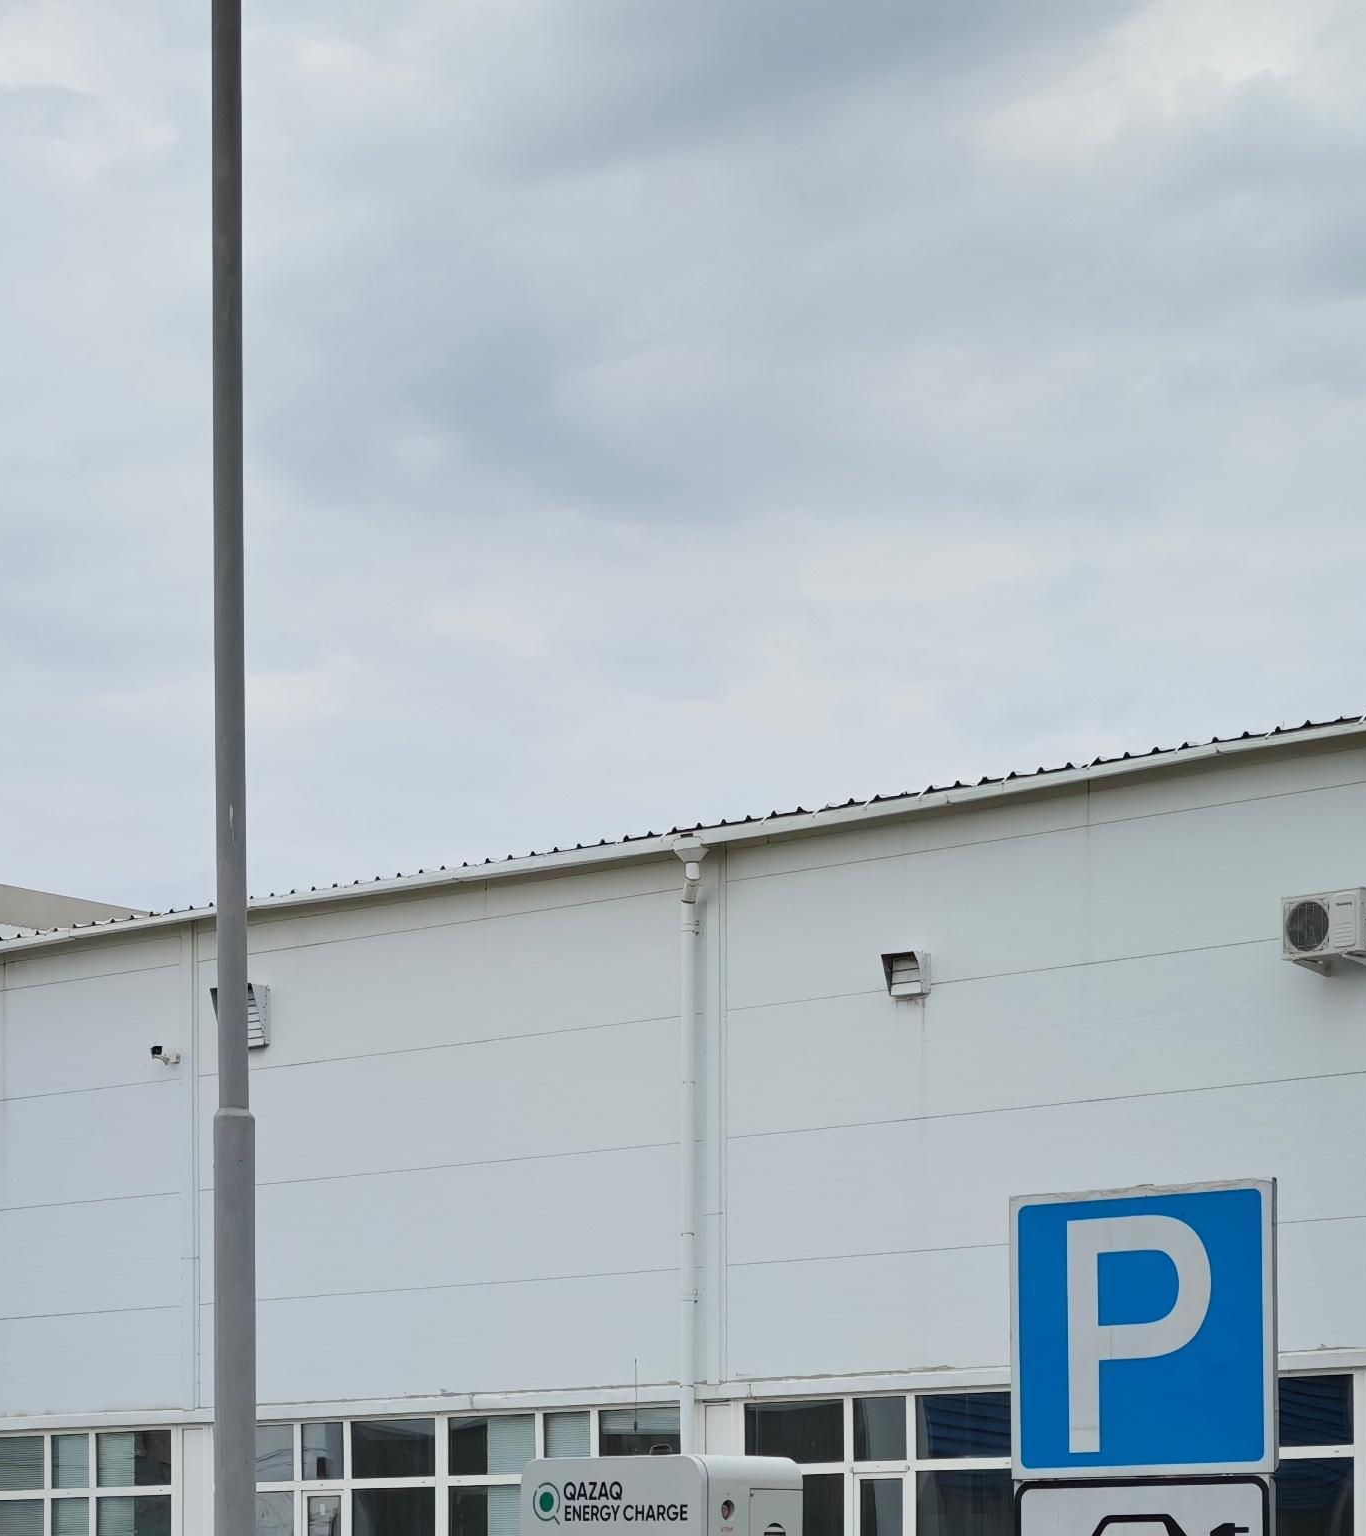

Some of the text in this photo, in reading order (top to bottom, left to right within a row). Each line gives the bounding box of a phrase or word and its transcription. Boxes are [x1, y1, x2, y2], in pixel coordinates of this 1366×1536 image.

[1066, 1215, 1212, 1454] P
[563, 1481, 623, 1501] QAZAQ
[564, 1504, 688, 1522] ENERGY CHARGE
